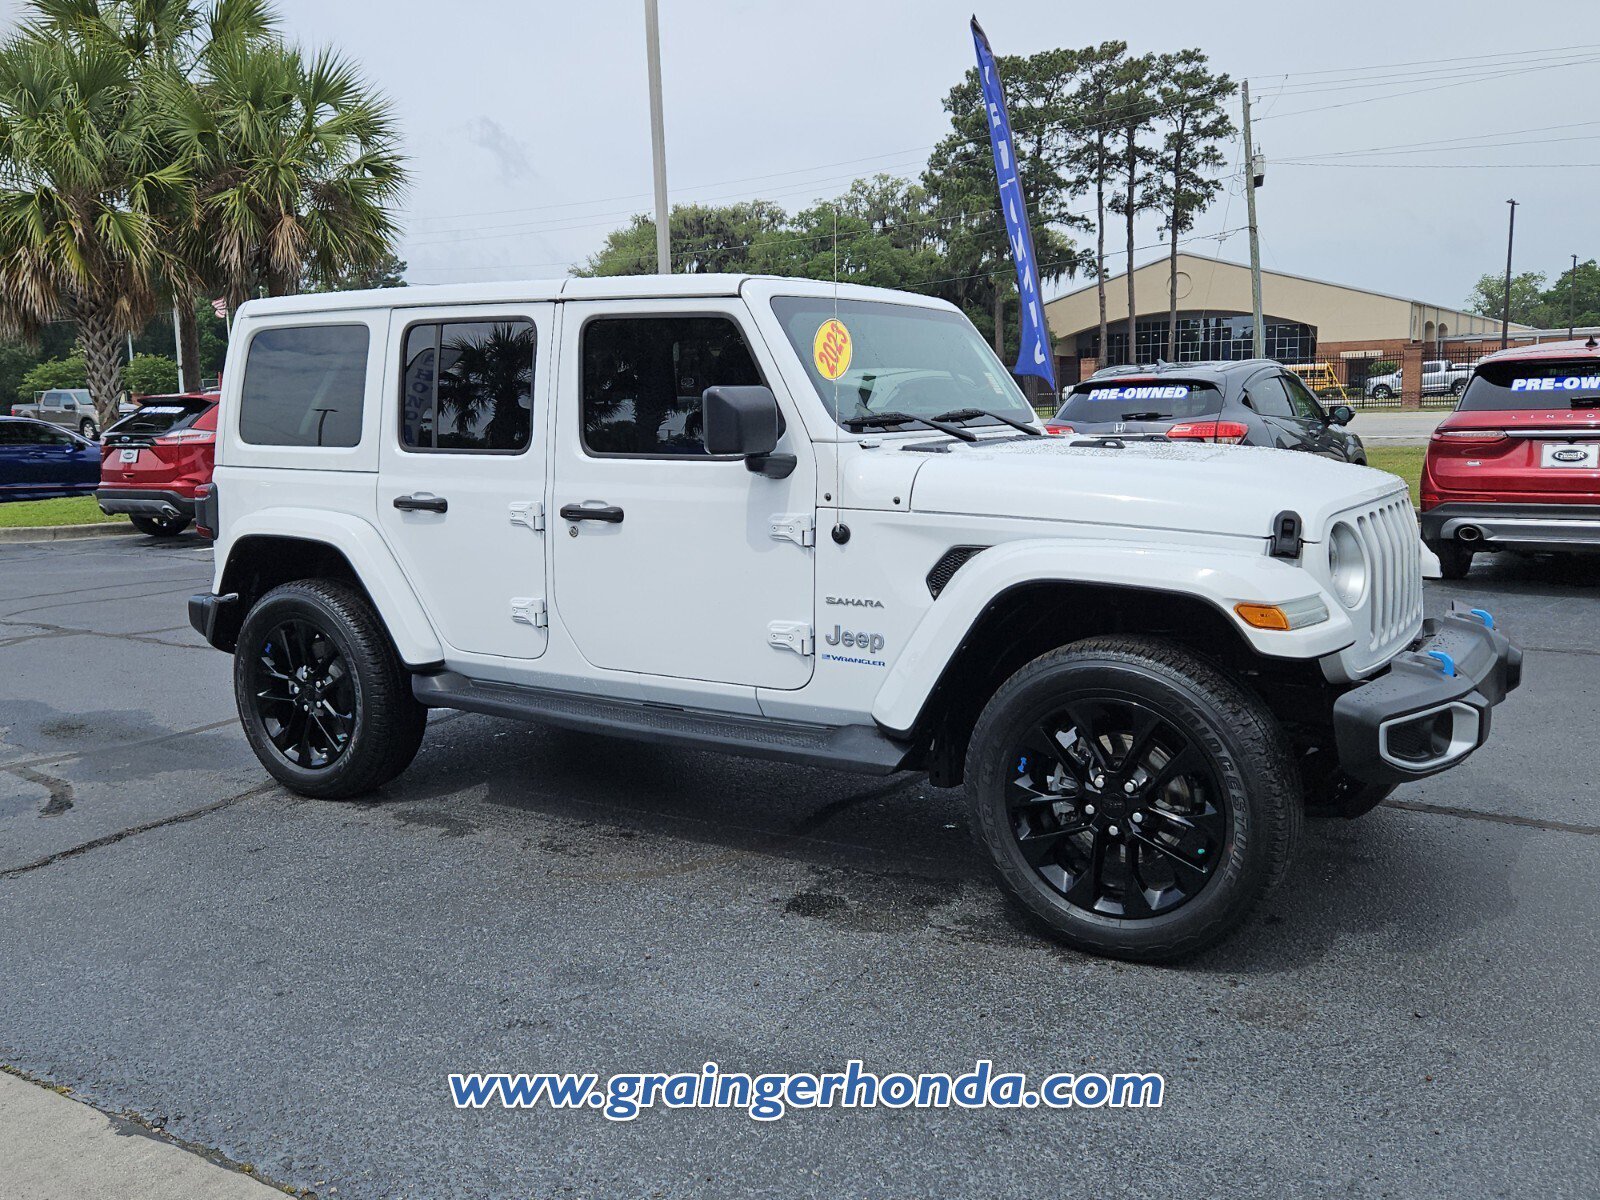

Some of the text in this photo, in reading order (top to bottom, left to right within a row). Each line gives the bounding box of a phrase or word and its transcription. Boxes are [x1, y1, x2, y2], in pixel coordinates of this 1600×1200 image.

[818, 322, 849, 377] 2023
[1088, 386, 1188, 400] PRE-OWNED
[825, 596, 885, 609] SAHARA
[825, 624, 885, 654] Jeep
[831, 654, 886, 667] WRANGLER
